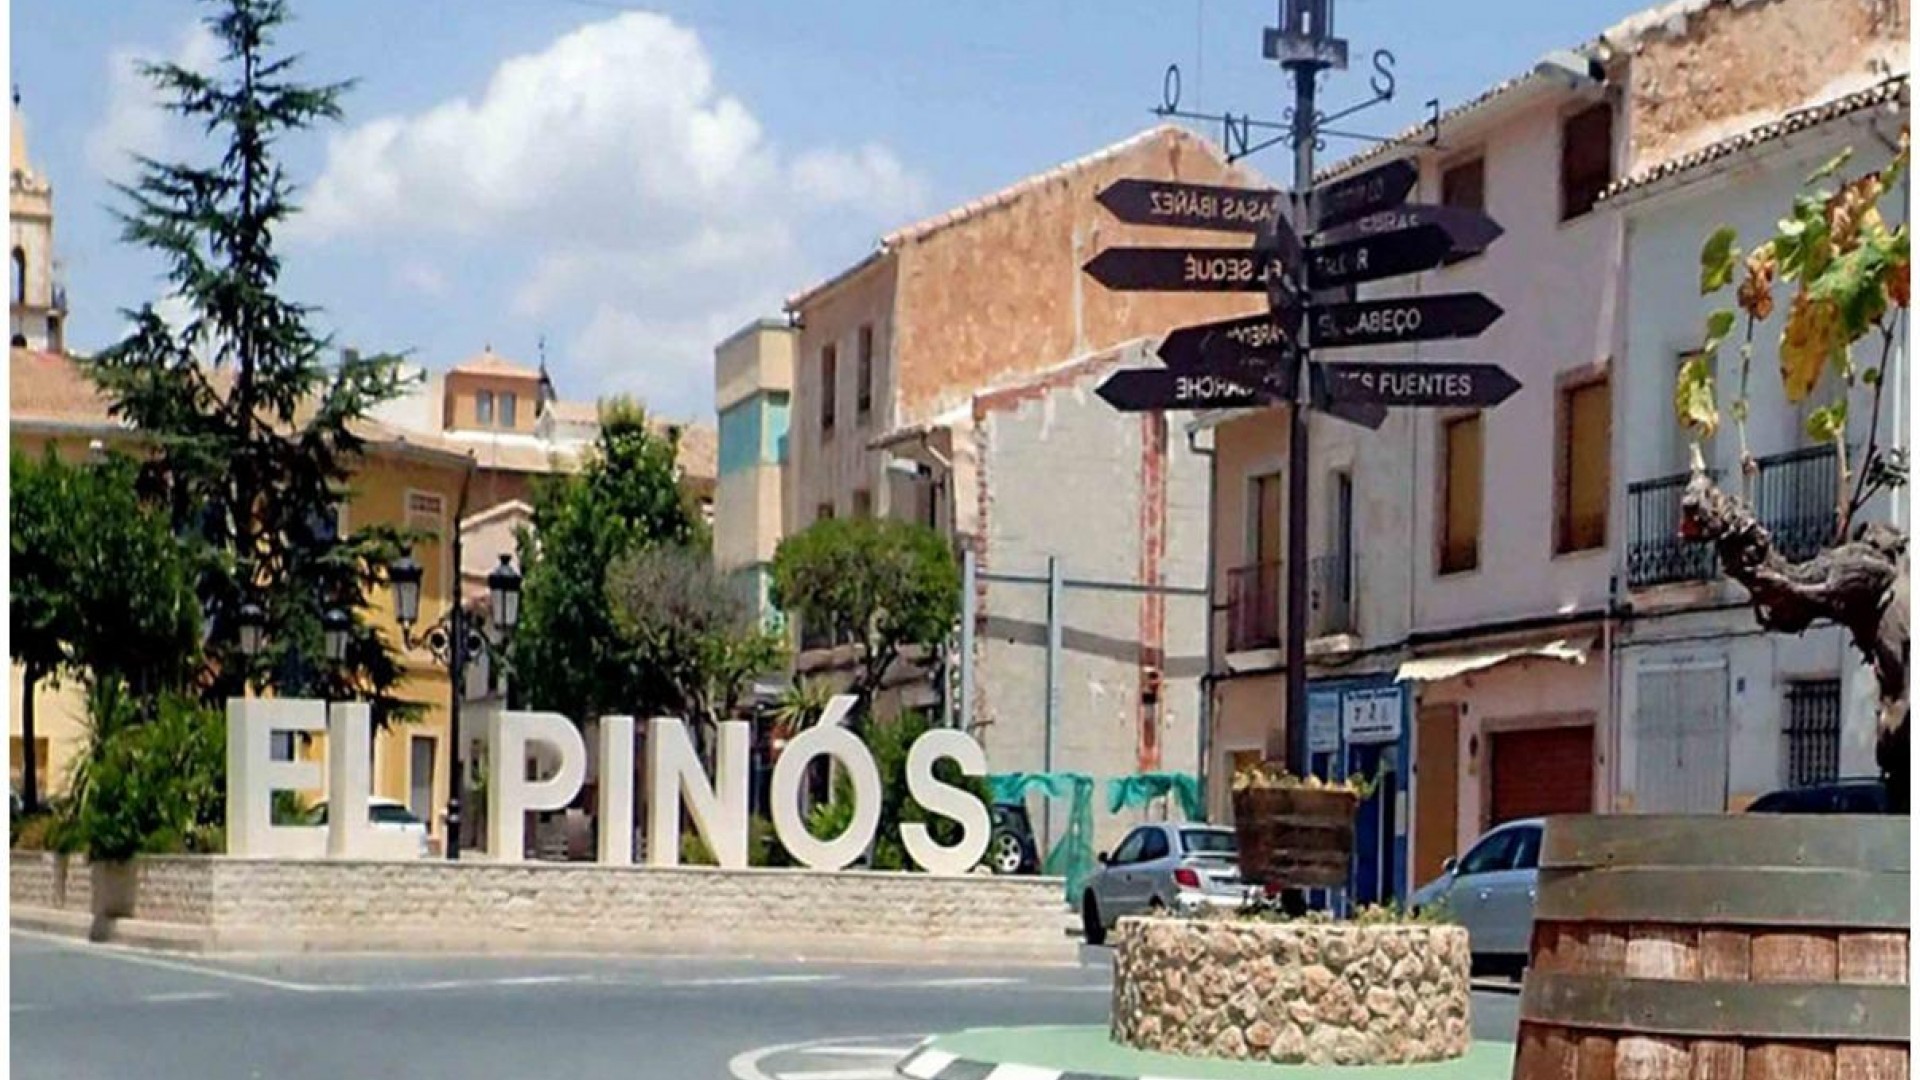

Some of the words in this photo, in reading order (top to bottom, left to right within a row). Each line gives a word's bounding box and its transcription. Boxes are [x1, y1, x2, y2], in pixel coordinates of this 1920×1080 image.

[1370, 49, 1395, 99] S
[1224, 112, 1248, 156] N
[1378, 372, 1473, 396] FUENTES
[227, 699, 420, 858] EL
[488, 694, 991, 873] PINÓS
